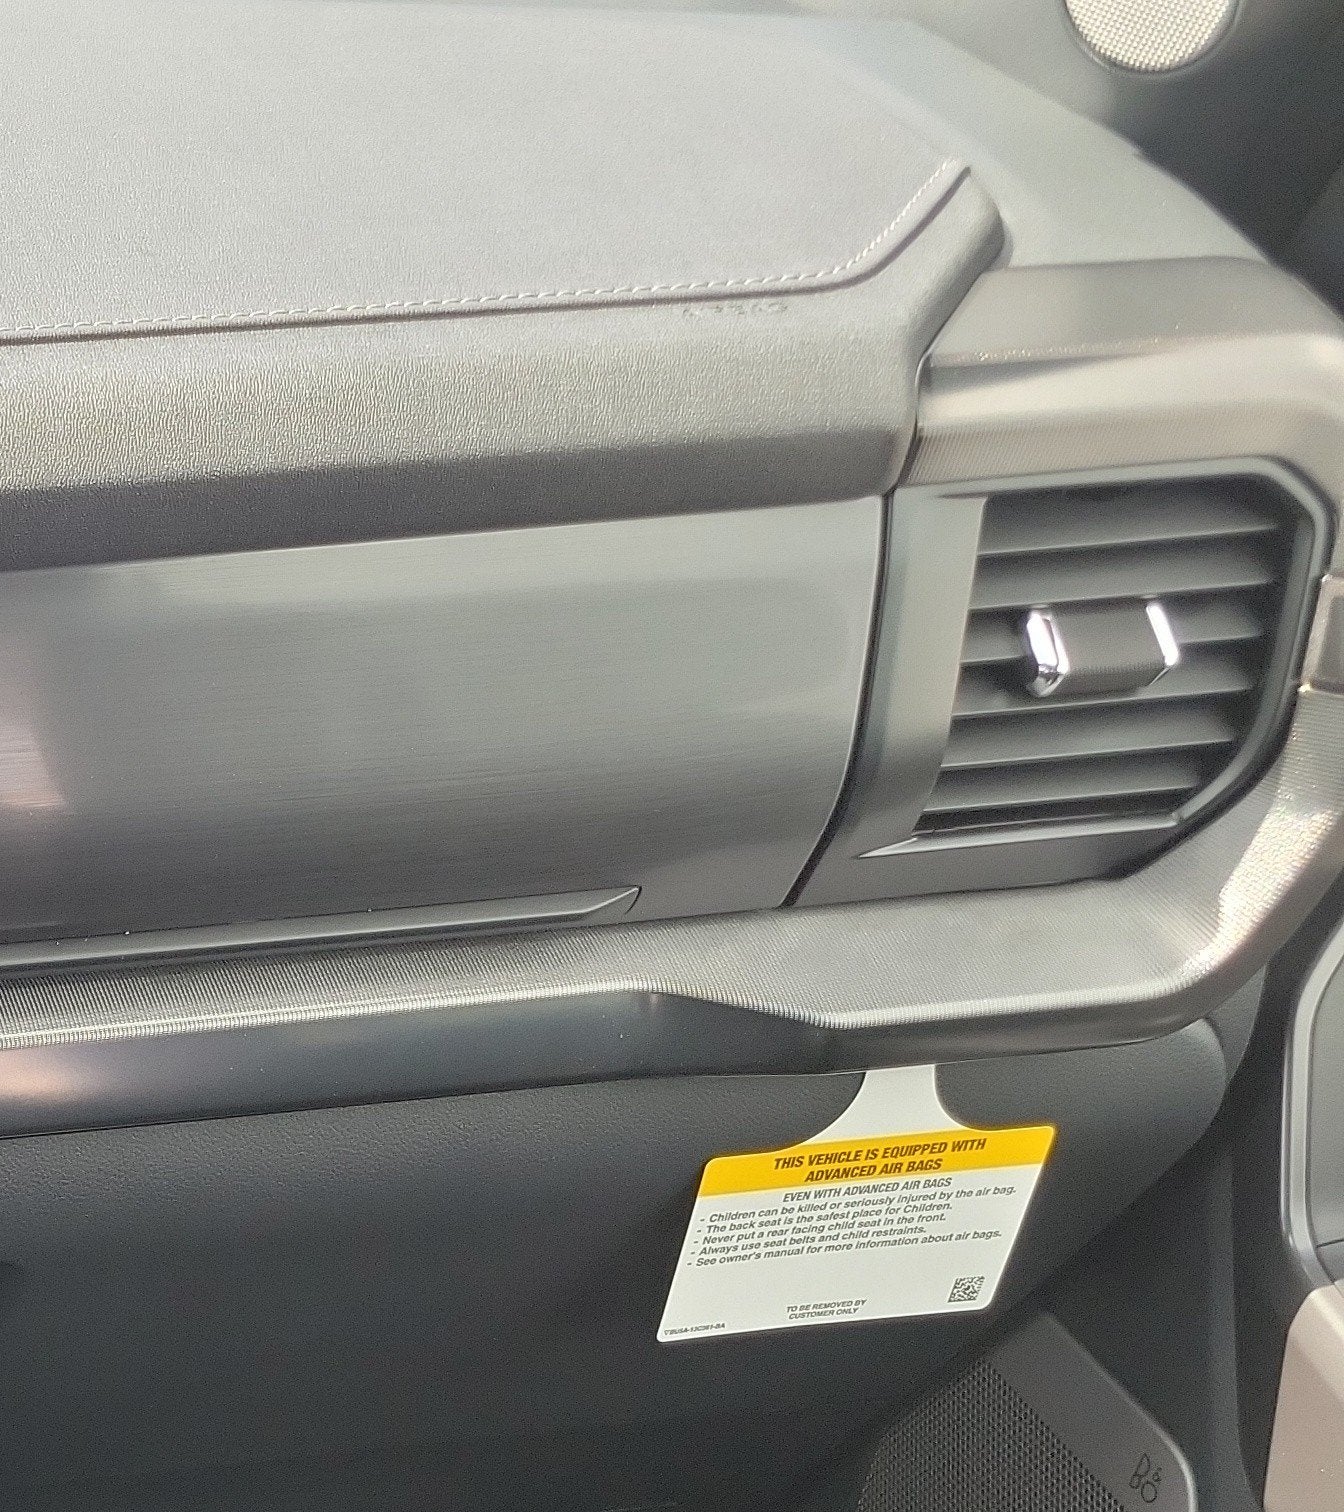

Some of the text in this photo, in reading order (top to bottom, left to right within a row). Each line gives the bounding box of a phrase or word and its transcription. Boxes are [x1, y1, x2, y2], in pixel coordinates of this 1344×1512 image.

[774, 1138, 987, 1170] THIS VEHICLE IS EQUIPPED WITH
[804, 1158, 944, 1182] ADVANCED AIR BAGS
[709, 1185, 1017, 1223] Children can be killed or seriously injured by the air bag.
[783, 1177, 953, 1203] EVEN WITH ADVANCED AIR BAGS
[702, 1234, 735, 1245] Never
[736, 1231, 755, 1243] put
[767, 1228, 790, 1238] rear
[792, 1223, 826, 1235] facing
[828, 1221, 855, 1232] child
[857, 1218, 881, 1229] seat
[883, 1217, 894, 1226] in
[897, 1216, 915, 1225] the
[917, 1213, 947, 1223] front.
[706, 1202, 953, 1234] The back seat is the safest place for Children.
[696, 1229, 1002, 1267] See owner's manual for more information about air bags.
[699, 1225, 927, 1256] Always use seat belts and child restraints.
[786, 1305, 798, 1313] TO
[799, 1304, 811, 1312] BE
[812, 1300, 853, 1310] REMOVED
[788, 1307, 859, 1320] CUSTOMER ONLY
